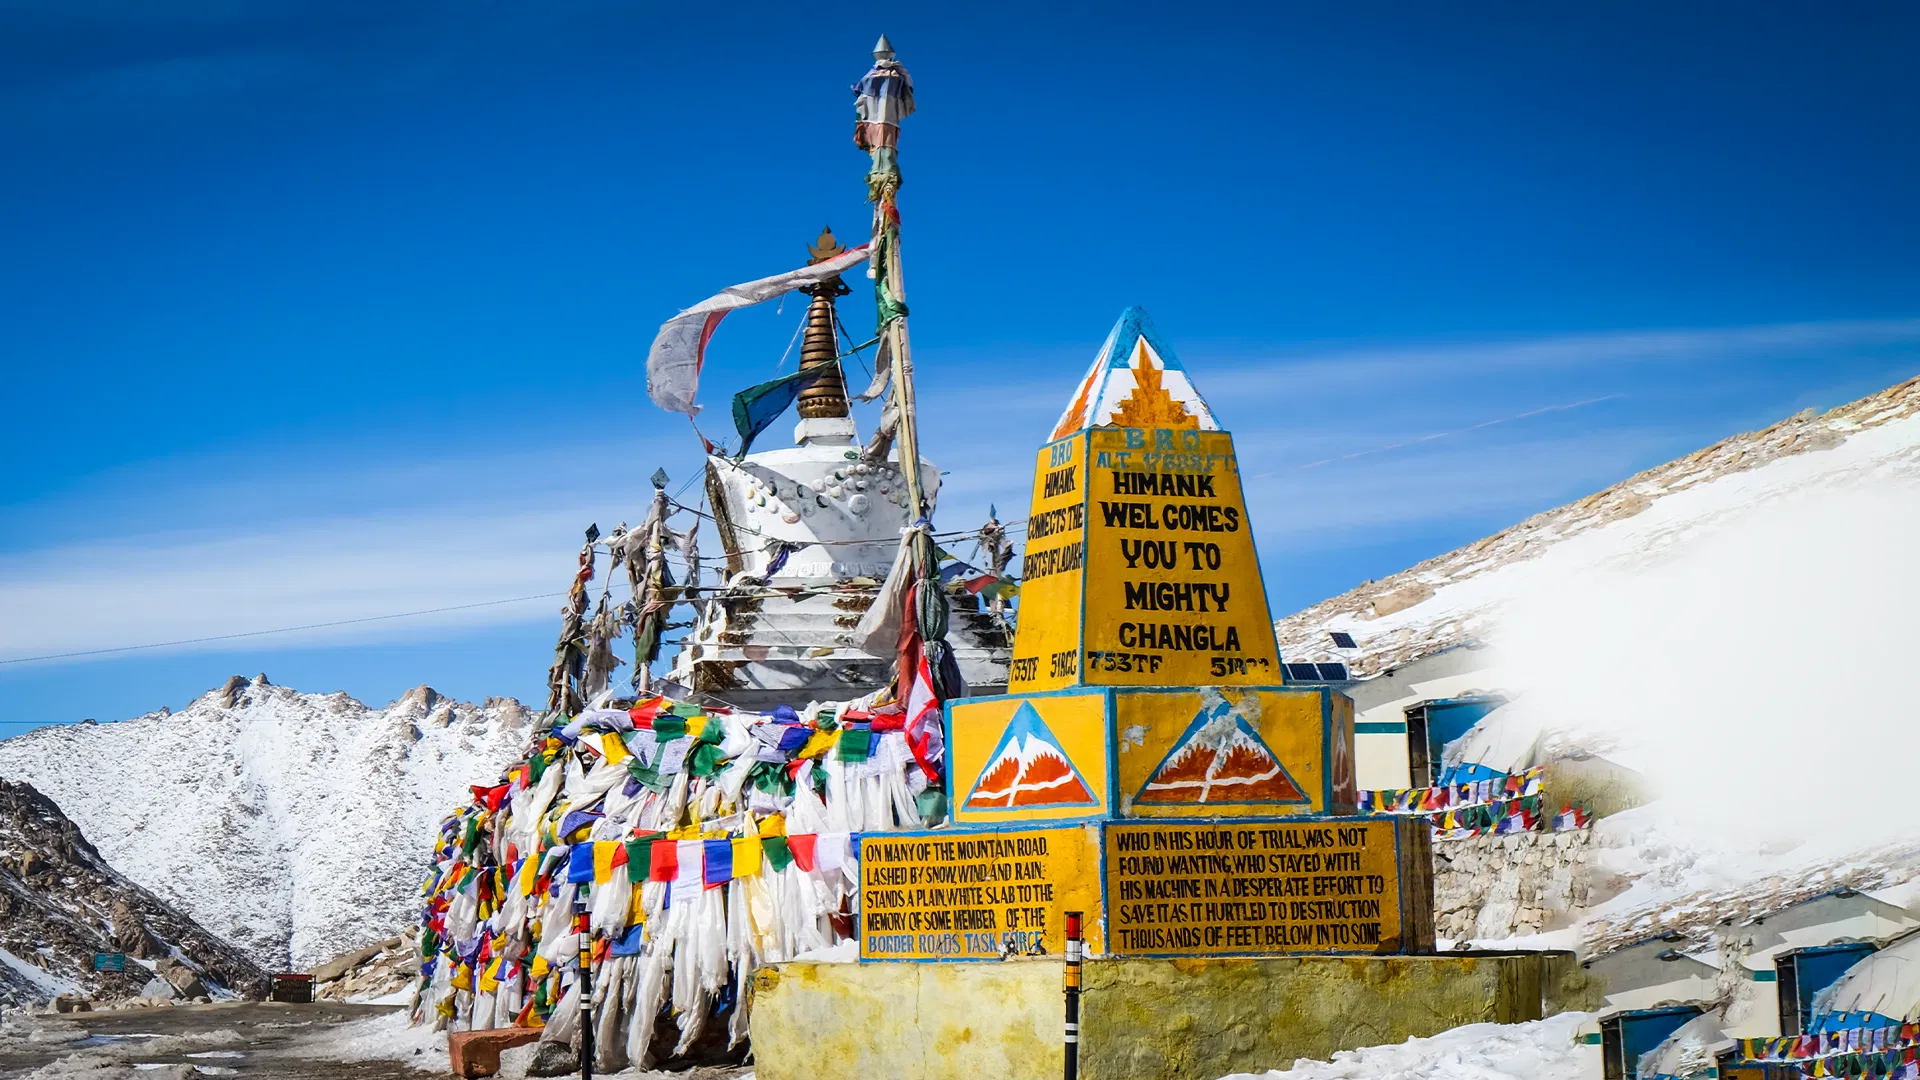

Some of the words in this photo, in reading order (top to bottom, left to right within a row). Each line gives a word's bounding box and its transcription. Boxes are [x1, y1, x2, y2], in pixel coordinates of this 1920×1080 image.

[1125, 427, 1201, 451] BRO
[1050, 440, 1073, 468] BRO
[1096, 451, 1131, 469] ALT
[1044, 465, 1077, 499] HIMANK
[1112, 471, 1217, 497] HIMANK
[1027, 508, 1067, 541] CONNECTS
[1067, 502, 1084, 531] THE
[1021, 550, 1049, 582] HEARTS
[1047, 548, 1058, 575] OF
[1120, 538, 1177, 570] YOU
[1184, 541, 1221, 570] TO
[1124, 581, 1230, 612] MIGHTY
[1118, 621, 1241, 651] CHANGLA
[1087, 650, 1163, 674] 753TF
[866, 844, 882, 862] ON
[884, 842, 916, 862] MANY
[916, 842, 931, 861] OF
[933, 841, 956, 861] THE
[957, 838, 1016, 860] MOUNTAIN
[1116, 832, 1150, 852] WHO
[1153, 831, 1168, 851] IN
[1169, 831, 1194, 851] HIS
[1195, 831, 1235, 850] HOUR
[1237, 830, 1257, 850] OF
[1302, 828, 1335, 849] WAS
[1337, 827, 1368, 848] NOT
[866, 866, 908, 886] LASHED
[910, 865, 925, 885] BY
[958, 863, 987, 884] WIND
[990, 862, 1012, 882] AND
[1118, 856, 1165, 876] FOUND
[1232, 854, 1266, 874] WHO
[1268, 852, 1321, 874] STAYED
[1322, 851, 1361, 872] WITH
[866, 889, 906, 909] STANDS
[906, 889, 915, 907] A
[945, 886, 984, 908] WHITE
[985, 885, 1016, 905] SLAB
[1016, 884, 1032, 903] TO
[1032, 883, 1054, 902] THE
[1119, 880, 1143, 900] HIS
[1144, 879, 1201, 900] MACHINE
[1204, 878, 1218, 898] IN
[1219, 878, 1232, 898] A
[1232, 876, 1310, 898] DESPERATE
[1313, 875, 1365, 897] EFFORT
[1365, 874, 1385, 895] TO
[867, 911, 907, 932] MEMORY
[908, 911, 923, 931] OF
[923, 910, 952, 931] SOME
[953, 908, 997, 931] MEMBER
[1006, 907, 1020, 928] OF
[1021, 906, 1046, 928] THE
[1119, 903, 1155, 925] SAVE
[1156, 903, 1170, 924] IT
[1169, 903, 1189, 923] AS
[1190, 902, 1204, 922] IT
[1205, 901, 1268, 922] HURTLED
[1268, 901, 1288, 921] TO
[1290, 899, 1381, 921] DESTRUCTION
[868, 934, 915, 954] BORDER
[918, 932, 961, 955] ROADS
[964, 931, 998, 953] TASK
[1118, 926, 1201, 950] THOUSANDS
[1204, 925, 1223, 948] OF
[1226, 924, 1262, 947] FEET
[1264, 923, 1314, 946] BELOW
[1350, 921, 1382, 945] SOME
